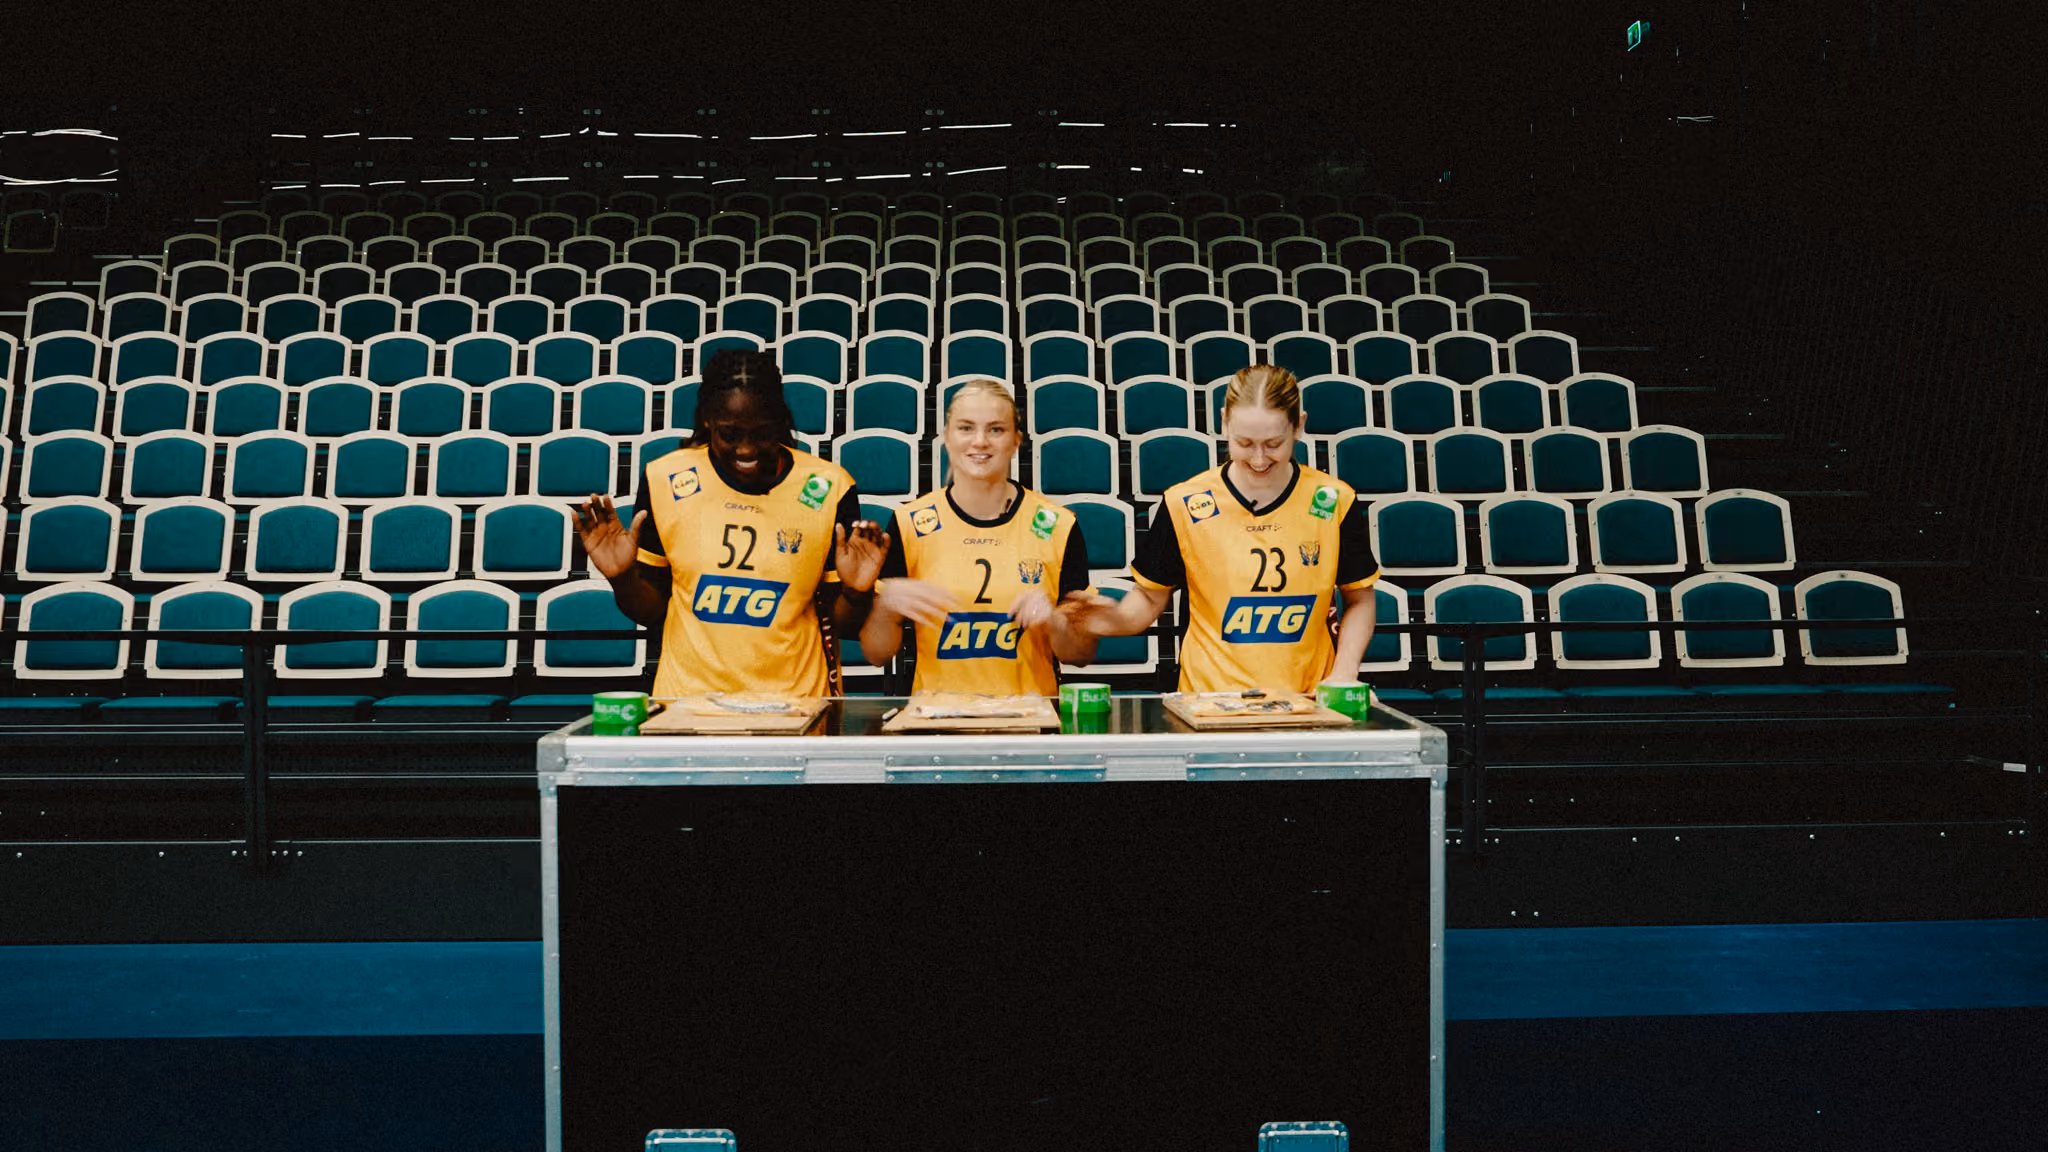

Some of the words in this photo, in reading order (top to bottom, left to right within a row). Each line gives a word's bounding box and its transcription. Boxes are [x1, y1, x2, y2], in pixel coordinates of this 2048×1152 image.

[724, 502, 755, 513] CRAFT
[962, 537, 994, 546] CRAFT
[1245, 525, 1273, 533] CRAFT
[718, 524, 758, 571] 52
[974, 558, 992, 604] 2
[1250, 547, 1287, 592] 23
[694, 584, 777, 618] ATG
[1224, 605, 1309, 634] ATG
[941, 621, 1018, 650] ATG
